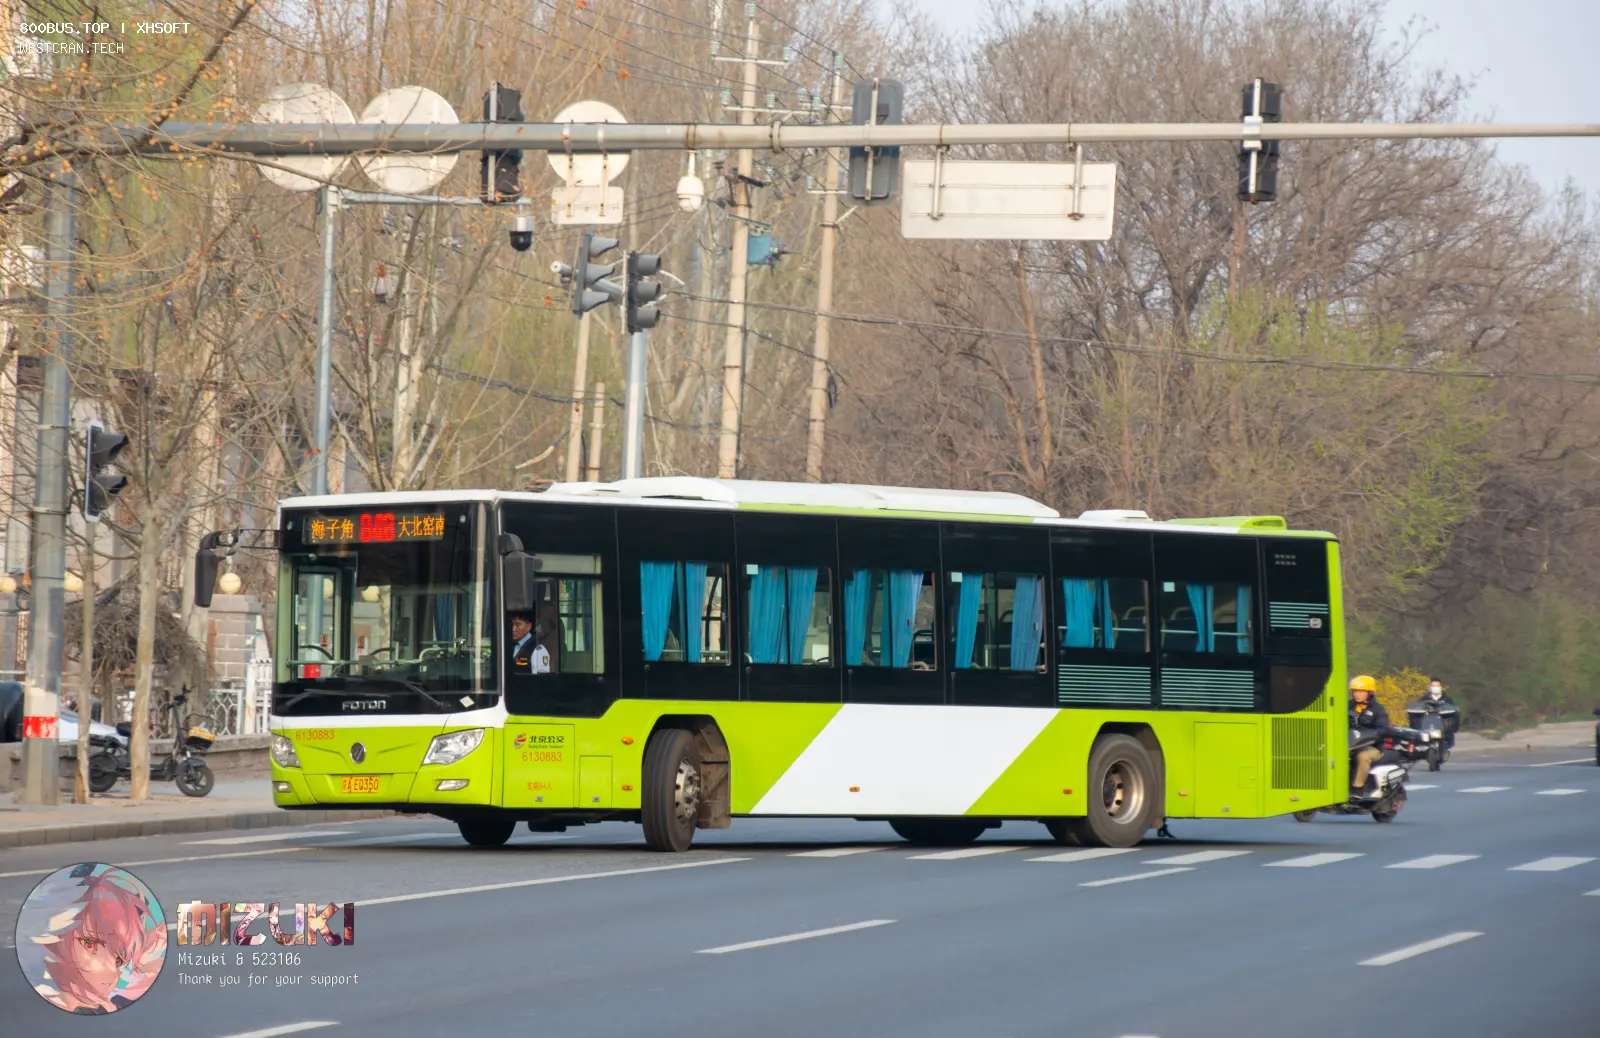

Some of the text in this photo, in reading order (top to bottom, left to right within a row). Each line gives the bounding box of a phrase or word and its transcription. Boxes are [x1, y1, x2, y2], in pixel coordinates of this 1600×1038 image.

[342, 700, 387, 711] FOTON
[295, 729, 335, 741] 6130883
[528, 735, 565, 744] 北京公交
[522, 751, 562, 762] 6130883
